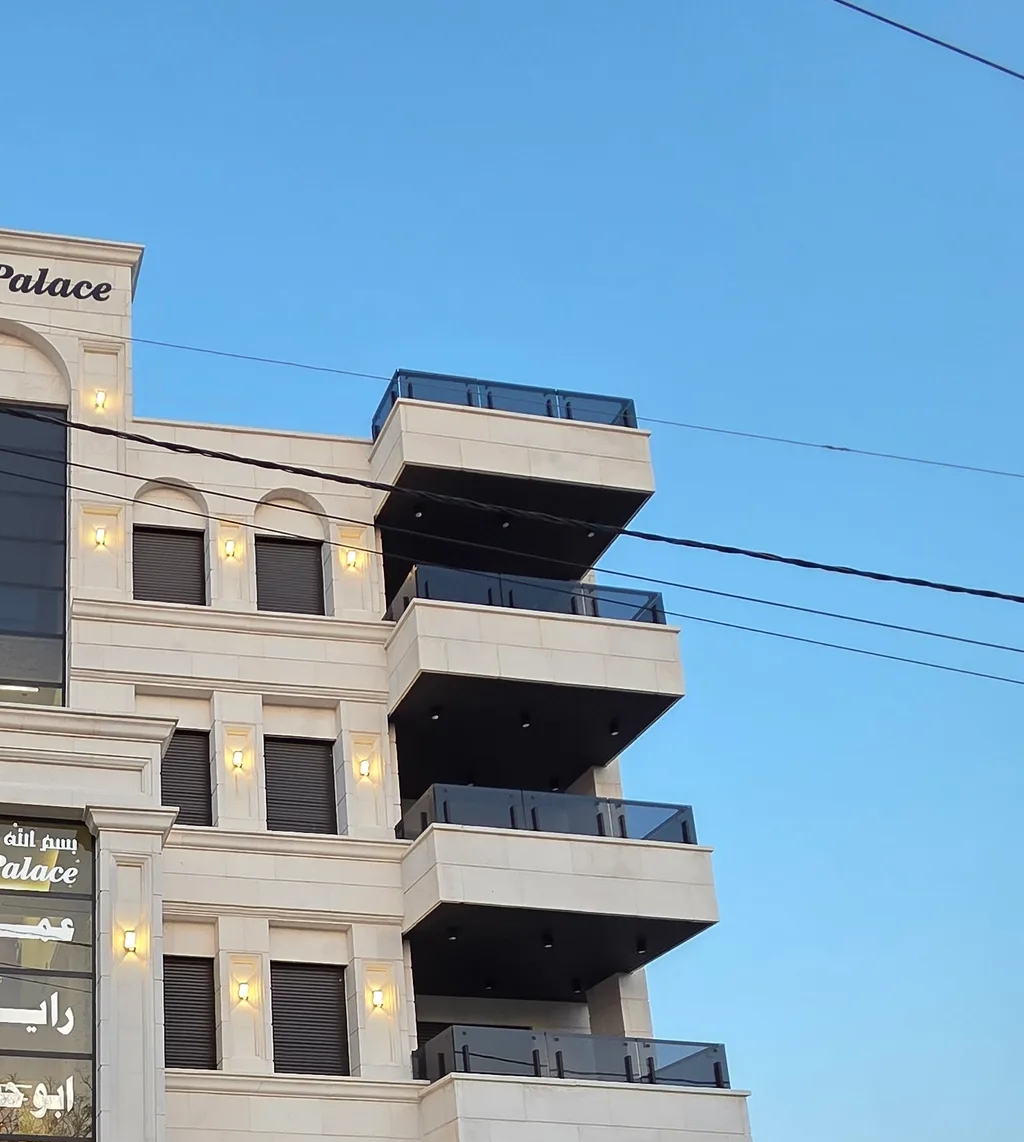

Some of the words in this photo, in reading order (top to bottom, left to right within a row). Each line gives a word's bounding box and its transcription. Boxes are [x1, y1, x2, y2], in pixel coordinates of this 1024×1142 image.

[3, 828, 37, 848] الله
[39, 834, 78, 855] بسم
[30, 1075, 74, 1119] ابو
